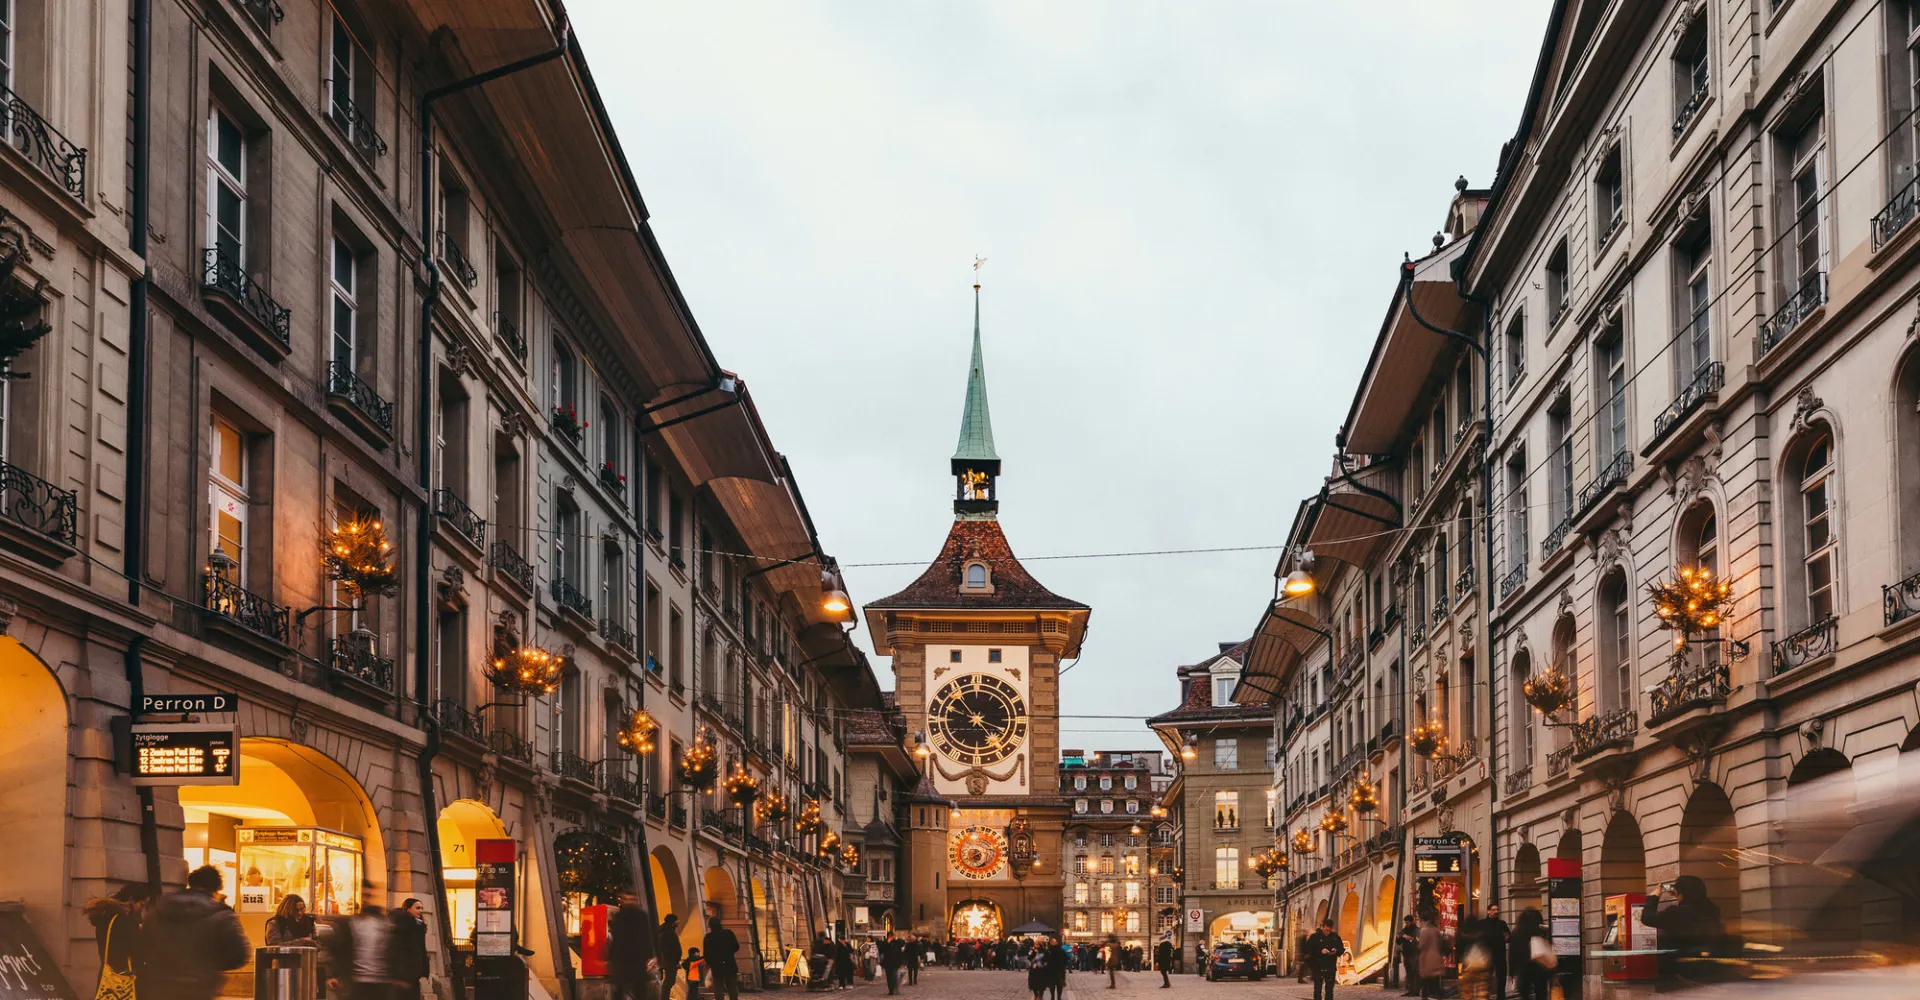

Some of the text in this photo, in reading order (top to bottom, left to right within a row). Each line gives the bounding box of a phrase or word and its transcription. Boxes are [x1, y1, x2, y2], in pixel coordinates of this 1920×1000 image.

[143, 696, 226, 710] Perron D
[135, 734, 169, 742] Zytglogge
[140, 748, 148, 757] 12
[140, 756, 148, 765] 12
[140, 764, 148, 773] 12
[453, 844, 465, 853] 71
[243, 894, 264, 904] äuä
